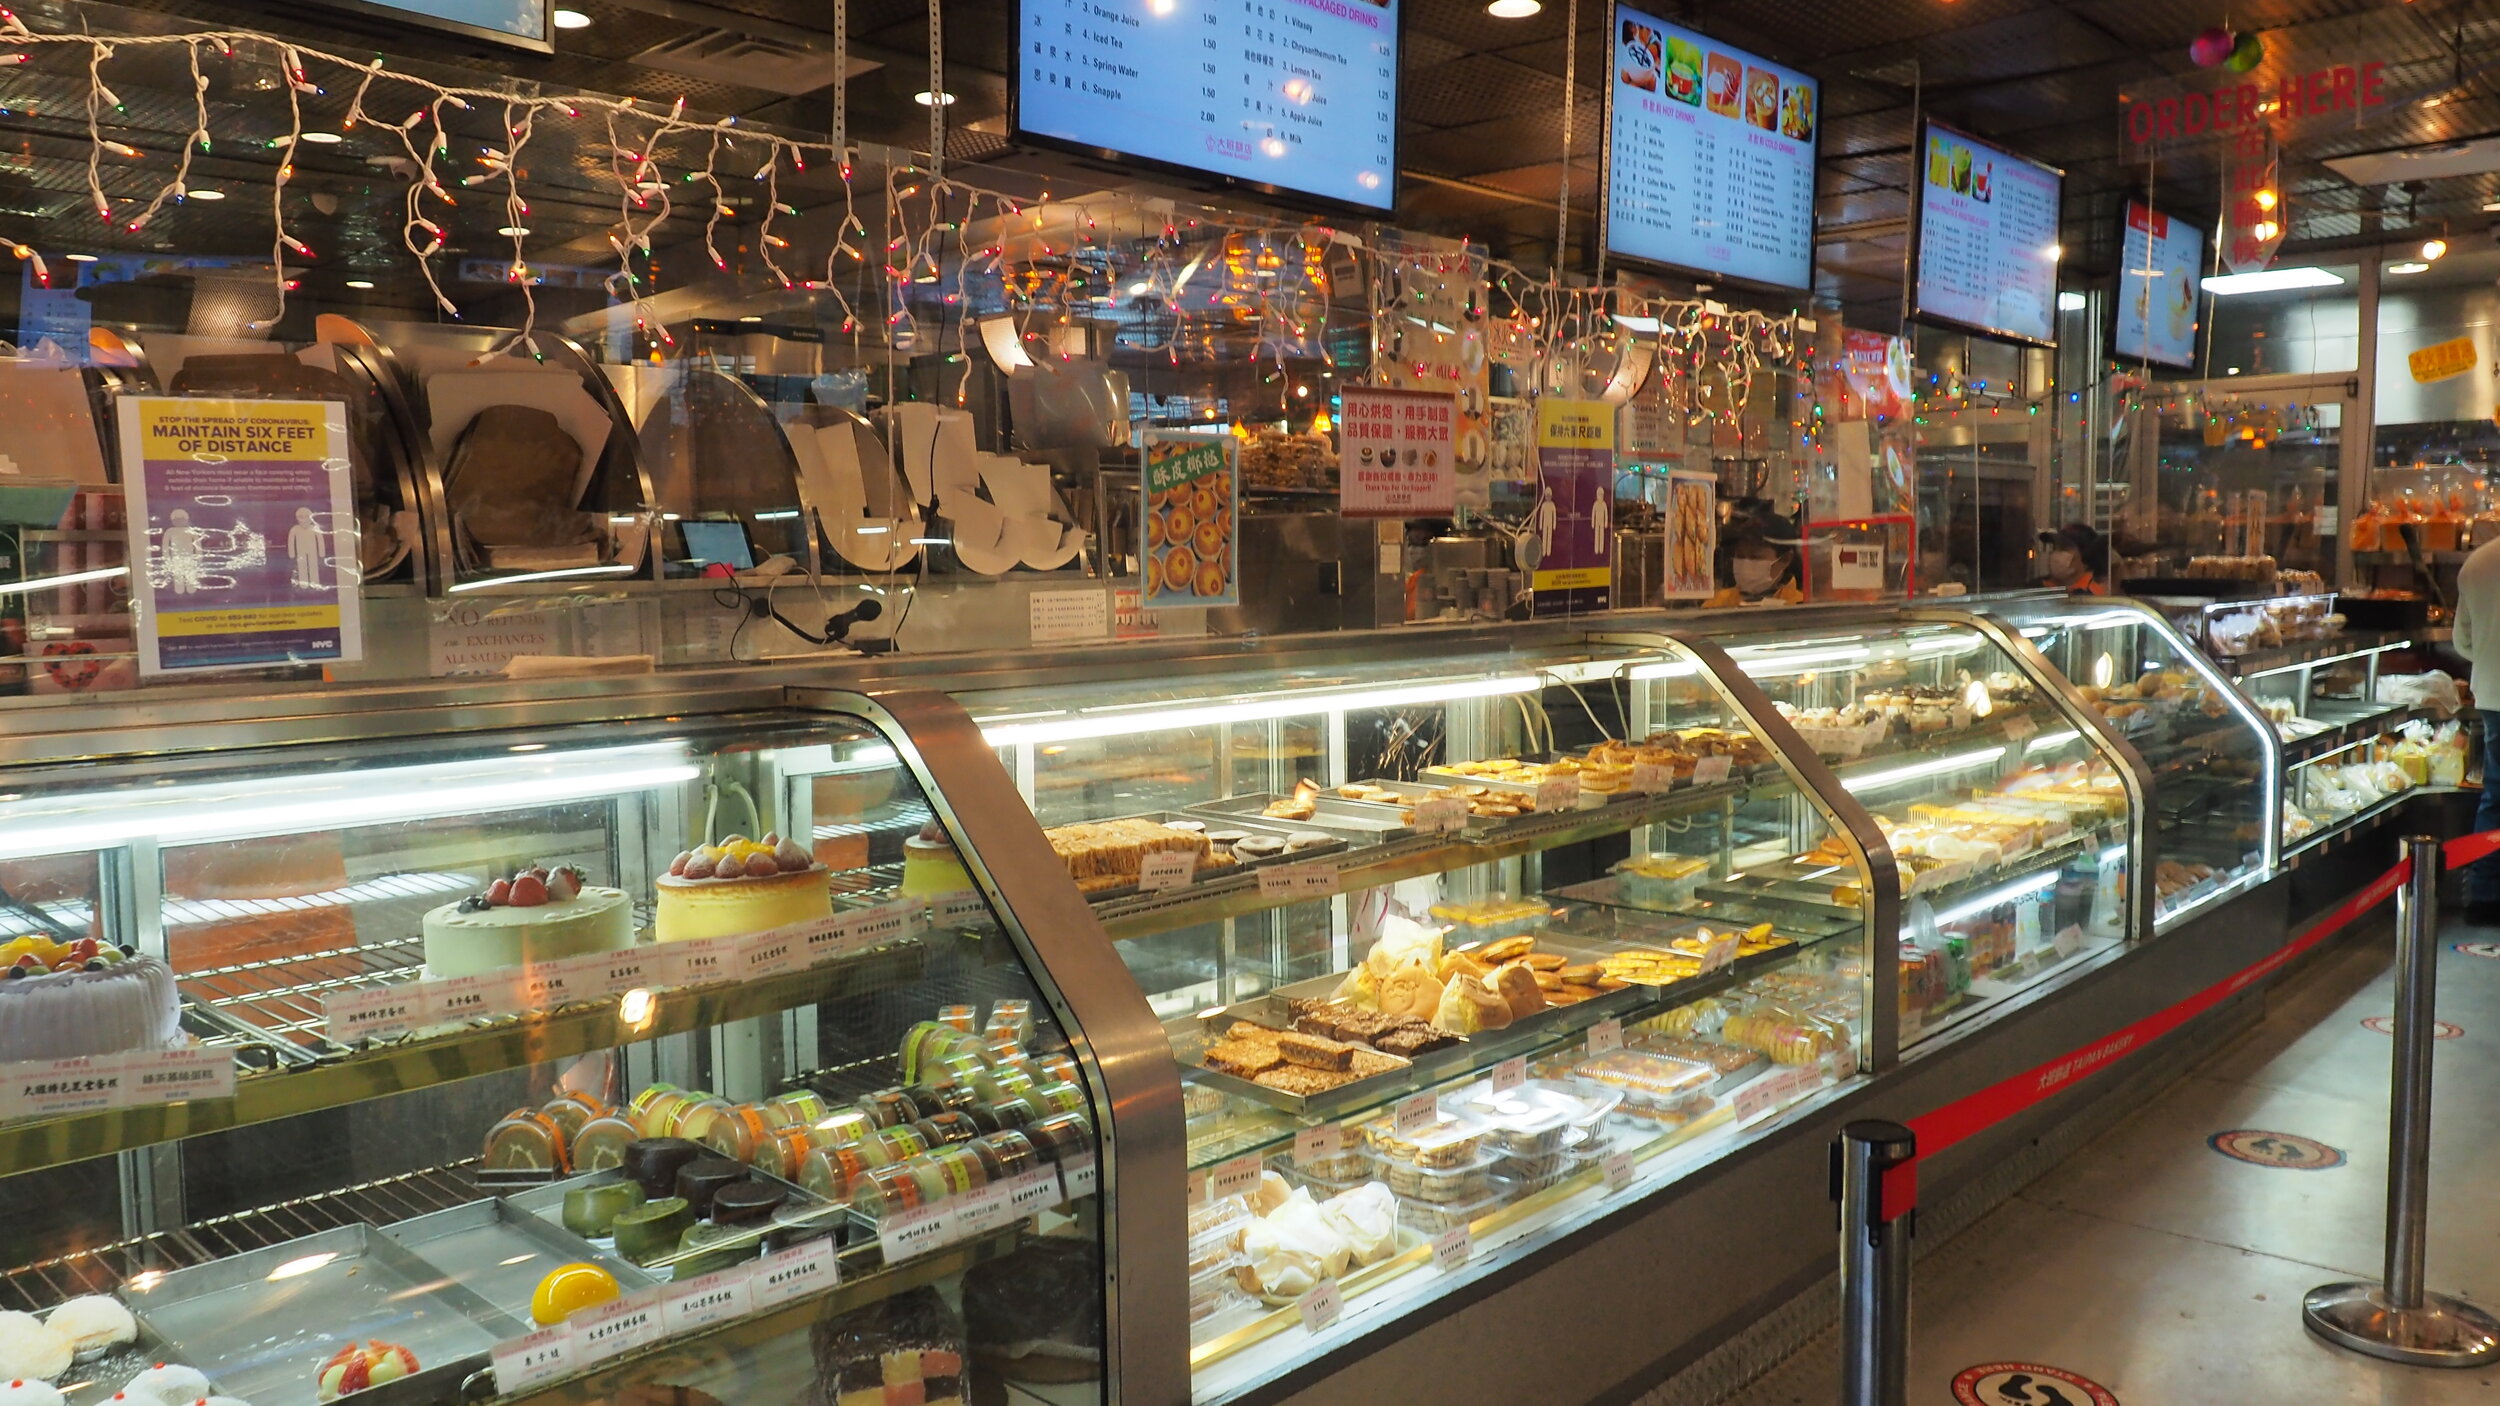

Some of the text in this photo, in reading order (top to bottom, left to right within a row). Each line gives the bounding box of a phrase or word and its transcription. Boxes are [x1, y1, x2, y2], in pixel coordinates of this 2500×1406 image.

[1094, 8, 1119, 23] Orange
[1121, 14, 1140, 28] Juice
[1203, 38, 1216, 50] 1.50
[1203, 13, 1217, 25] 1.50
[1348, 9, 1378, 29] DRINKS
[1094, 31, 1109, 45] Iced
[1110, 36, 1123, 49] Tea
[1203, 62, 1216, 74] 1.50
[1292, 40, 1337, 62] Chrysanthemum
[1338, 53, 1348, 65] Tea
[1379, 68, 1389, 78] 1.25
[1379, 45, 1390, 56] 1.25
[1093, 58, 1117, 75] Spring
[1118, 63, 1139, 79] Water
[1202, 87, 1215, 98] 1.50
[1312, 69, 1322, 81] Tea
[1378, 90, 1389, 100] 1.25
[1093, 83, 1122, 100] Snapple
[1201, 111, 1215, 123] 2.00
[2128, 61, 2386, 144] ORDER HERE
[1290, 110, 1306, 124] Apple
[1377, 133, 1387, 144] 1.25
[1378, 112, 1388, 122] 1.25
[1290, 133, 1302, 144] Milk
[1377, 155, 1387, 165] 1.25
[153, 425, 315, 439] MAINTAIN SIX FEET
[178, 440, 292, 453] OF DISTANCE
[312, 641, 333, 649] NYC
[466, 633, 545, 647] EXCHANGES
[446, 654, 464, 665] ALL
